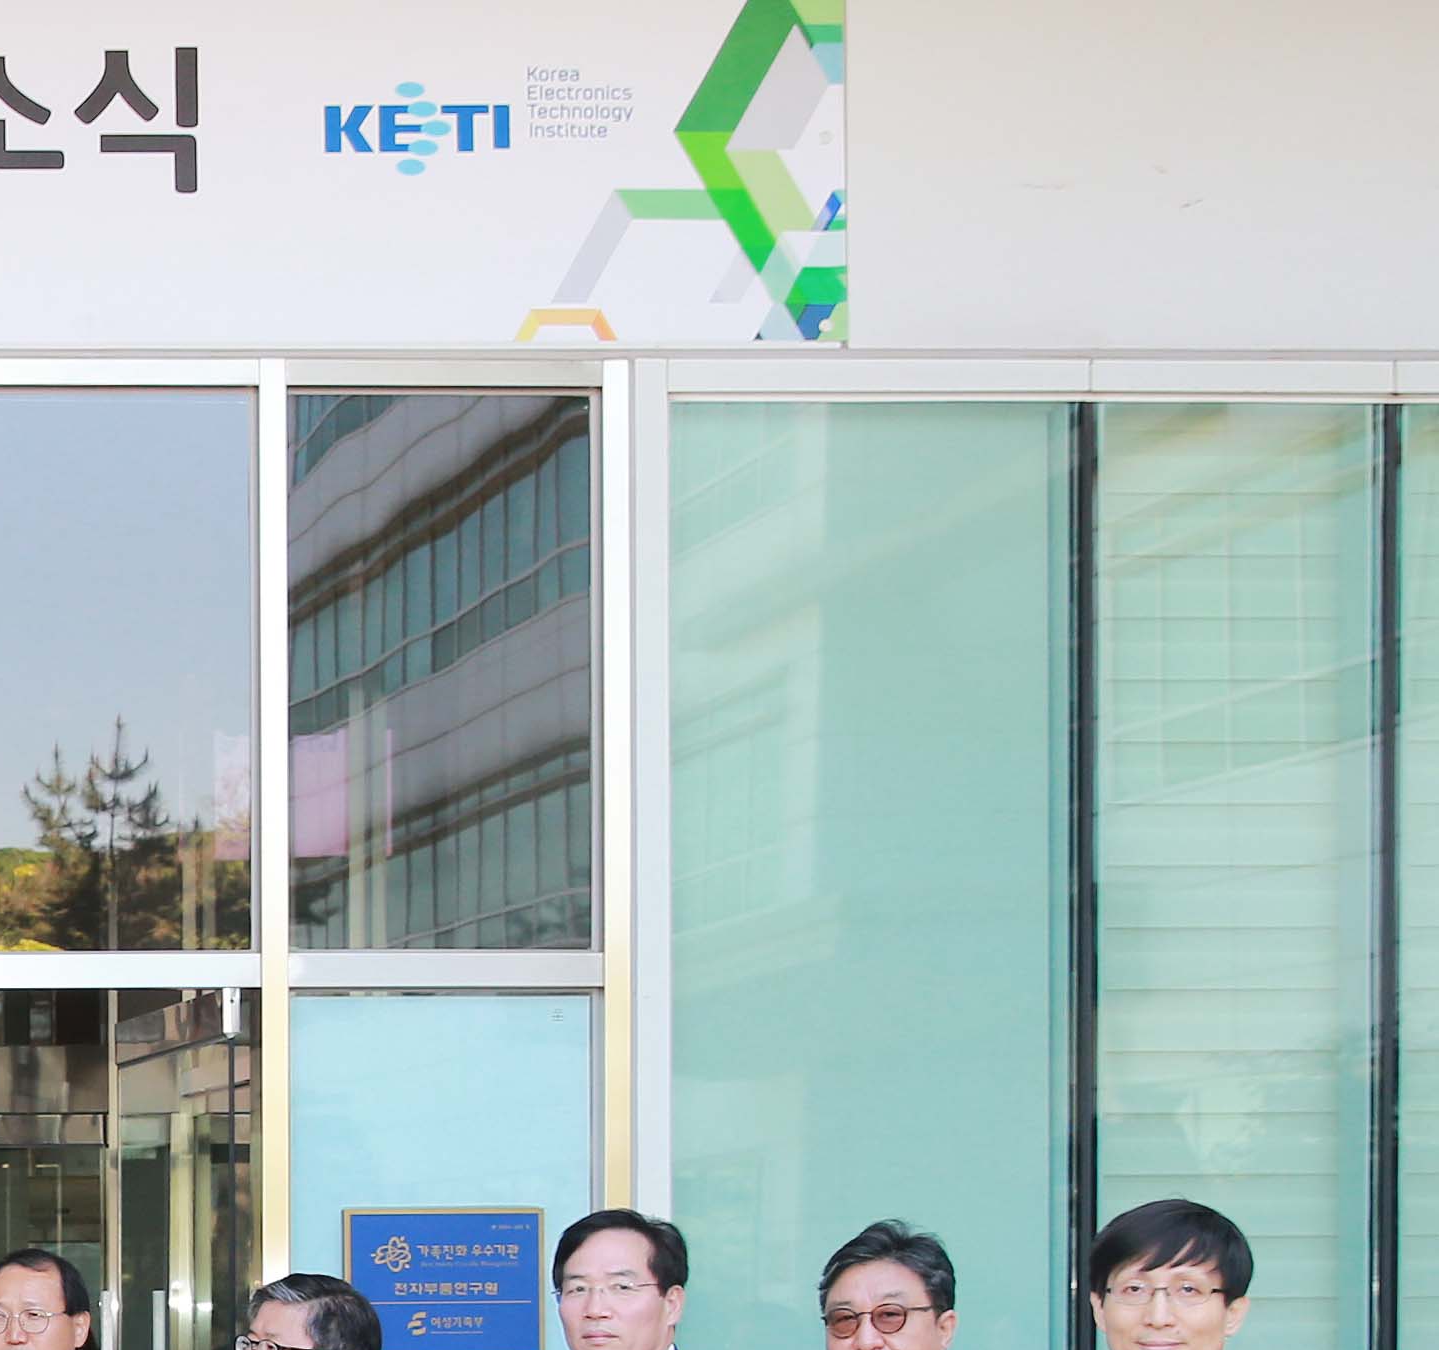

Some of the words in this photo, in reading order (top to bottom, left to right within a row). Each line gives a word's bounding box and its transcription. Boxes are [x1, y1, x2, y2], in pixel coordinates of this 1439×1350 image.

[526, 65, 580, 83] Korea
[526, 84, 633, 102] Electronics
[527, 103, 634, 122] Technology
[323, 103, 512, 153] KETI
[529, 122, 609, 139] Institute
